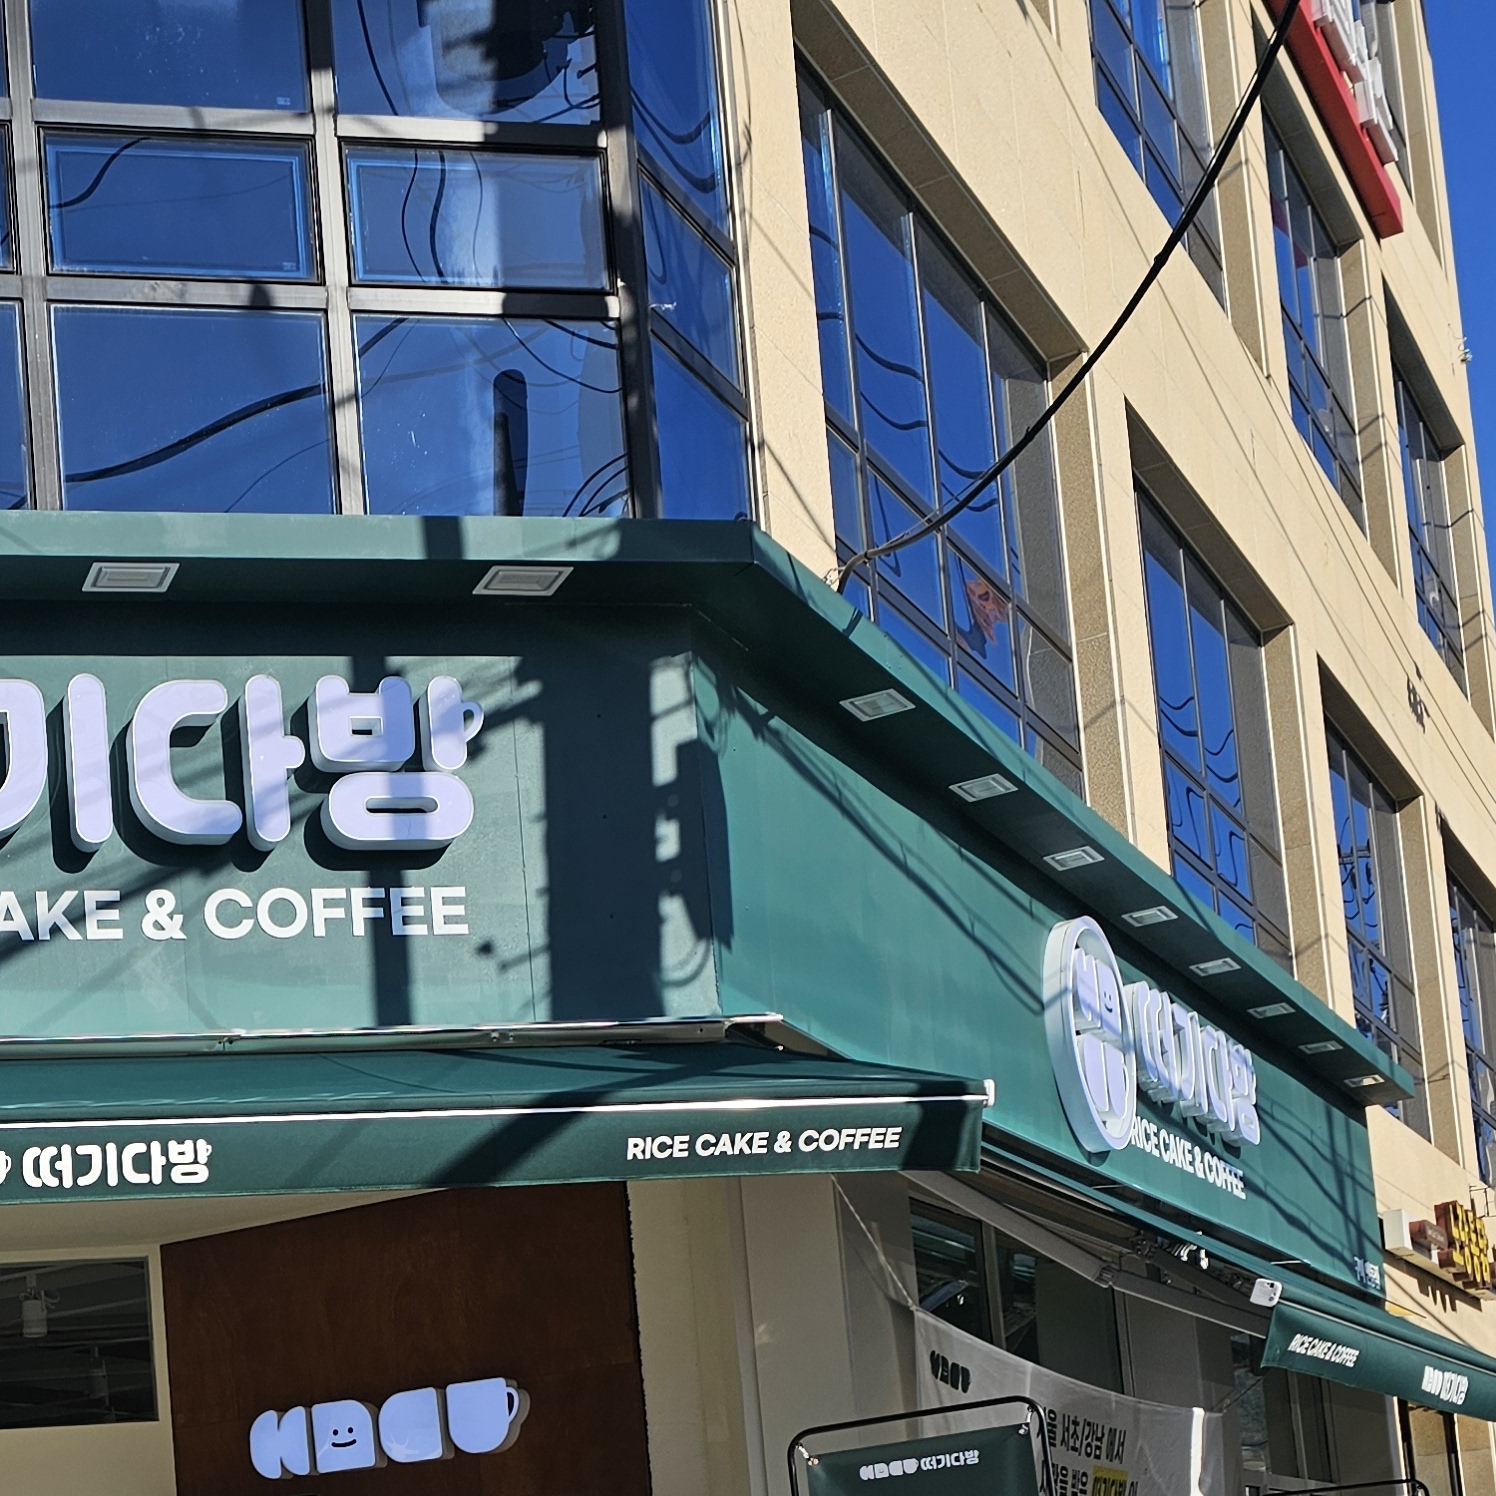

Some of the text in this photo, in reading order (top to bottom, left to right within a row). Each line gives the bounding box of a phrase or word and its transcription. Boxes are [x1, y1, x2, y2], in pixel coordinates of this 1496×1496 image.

[142, 888, 187, 941] &
[202, 884, 469, 939] COFFEE
[22, 1138, 212, 1188] 떠기다방
[626, 1126, 902, 1160] RICE CAKE & COFFEE
[1131, 1115, 1246, 1200] RICE CAKE & COFFEE
[1307, 1338, 1332, 1361] CAKE
[1330, 1345, 1360, 1368] COFFEE
[920, 1449, 980, 1471] 떠기다방
